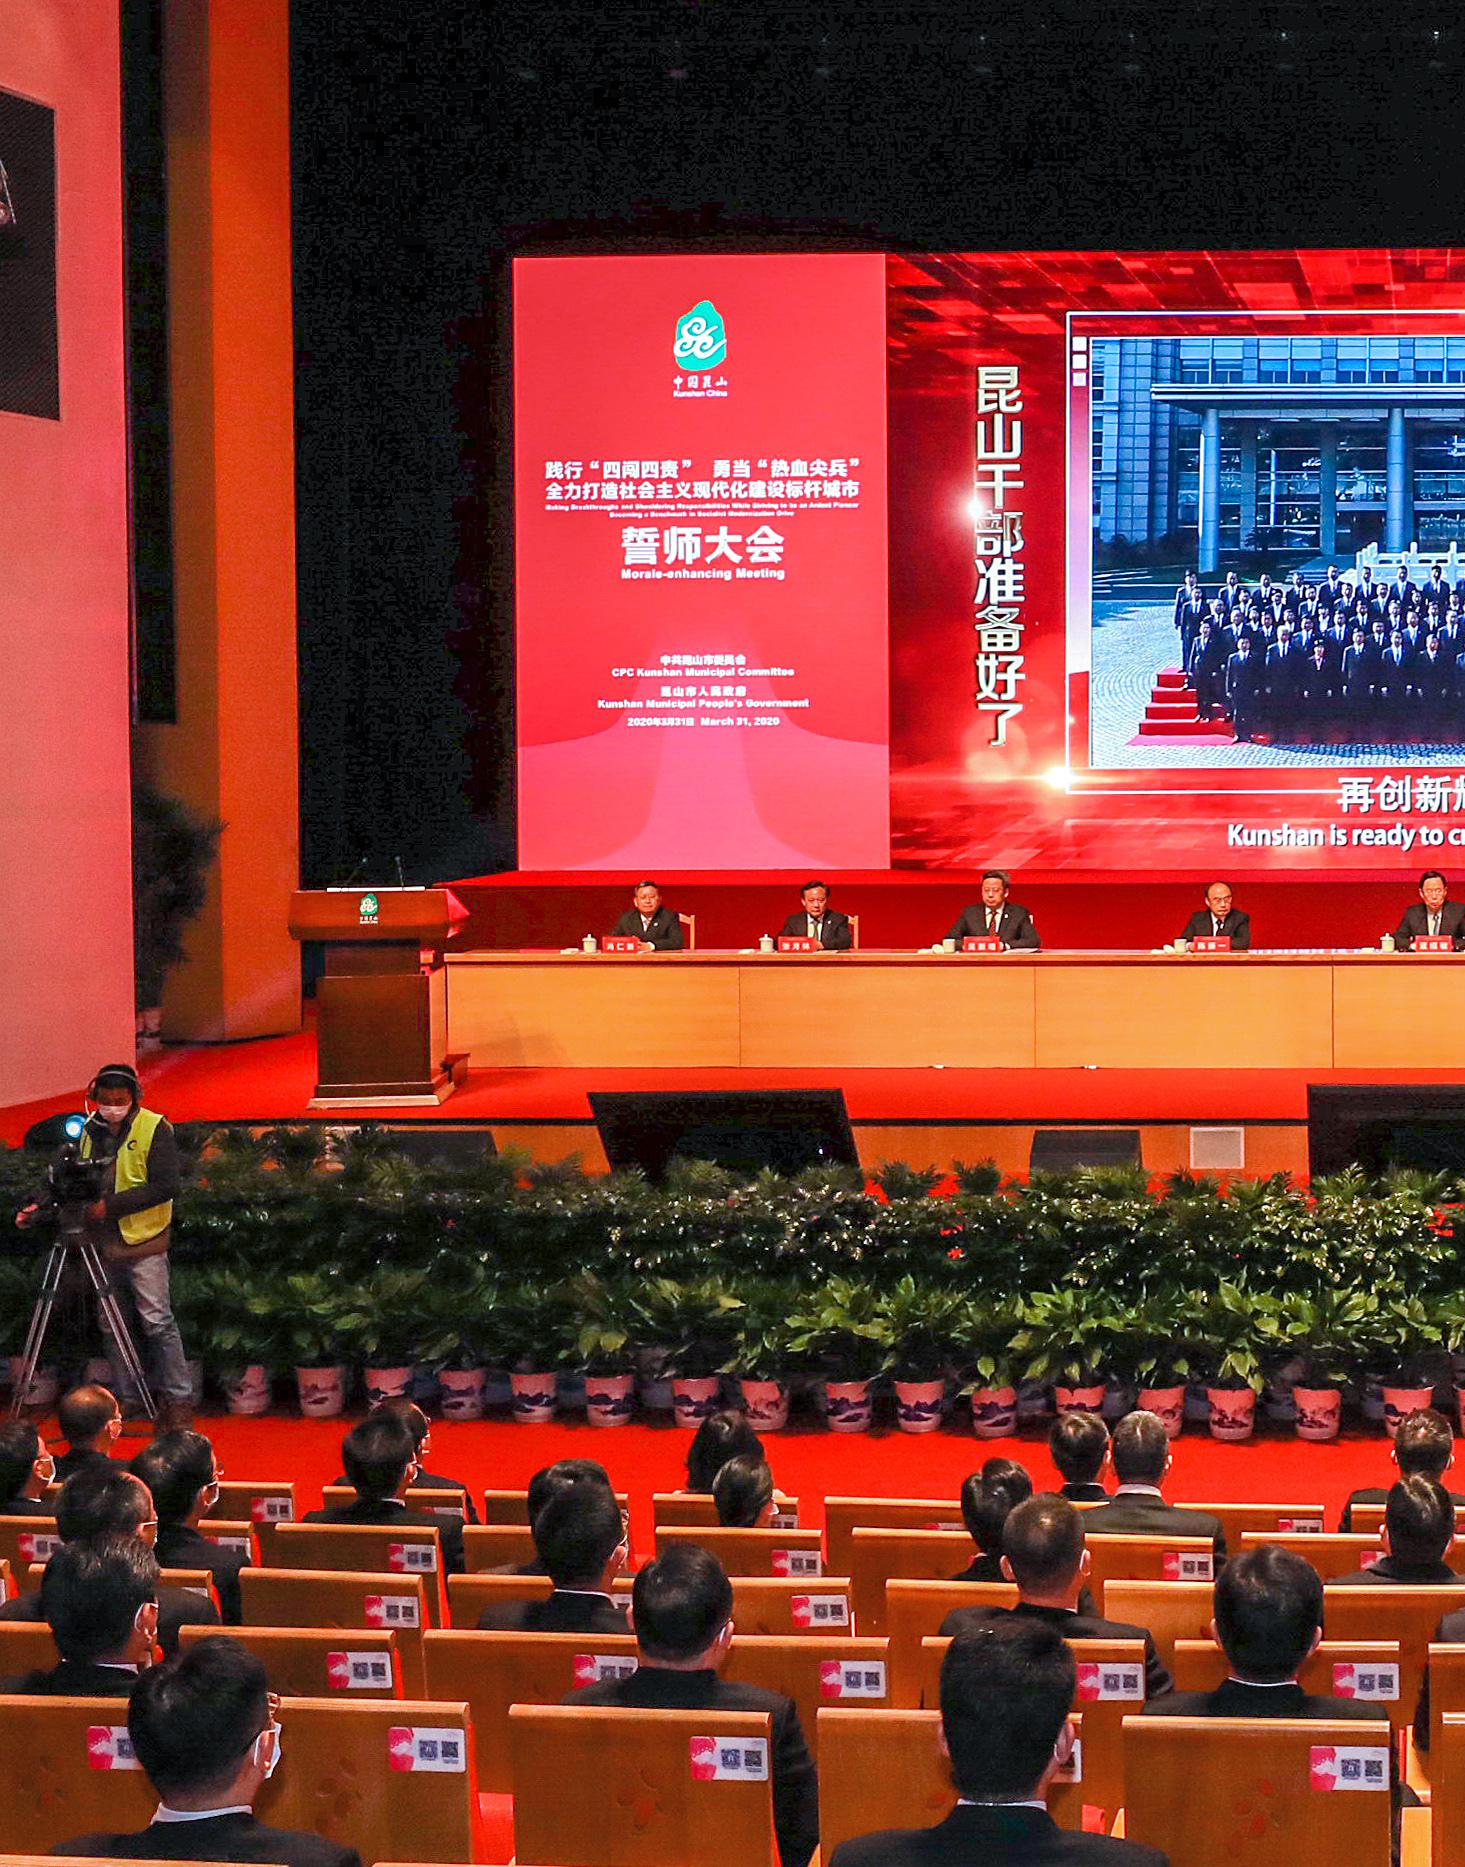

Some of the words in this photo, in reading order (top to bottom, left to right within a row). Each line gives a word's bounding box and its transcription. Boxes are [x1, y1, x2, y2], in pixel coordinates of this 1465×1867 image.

[705, 389, 728, 397] China
[545, 479, 860, 501] 全力打造社会主义现代化建设标杆城市
[621, 525, 785, 566] 誓师大会
[974, 365, 1026, 748] 昆山干部准备好了
[621, 567, 733, 581] Morale-enhancing
[735, 567, 786, 581] Meeting
[611, 667, 635, 677] CPC
[636, 667, 683, 677] Kunshan
[684, 667, 736, 679] Municipal
[737, 667, 795, 677] Committee
[597, 699, 644, 709] Kunshan
[645, 698, 697, 710] Municipal
[697, 698, 744, 710] People's
[745, 698, 810, 708] Government
[700, 715, 735, 727] March
[735, 716, 753, 727] 31,
[753, 716, 781, 727] 2020
[1227, 824, 1325, 847] Kunshan
[1329, 824, 1348, 847] is
[1352, 824, 1415, 851] ready
[1419, 827, 1444, 847] to
